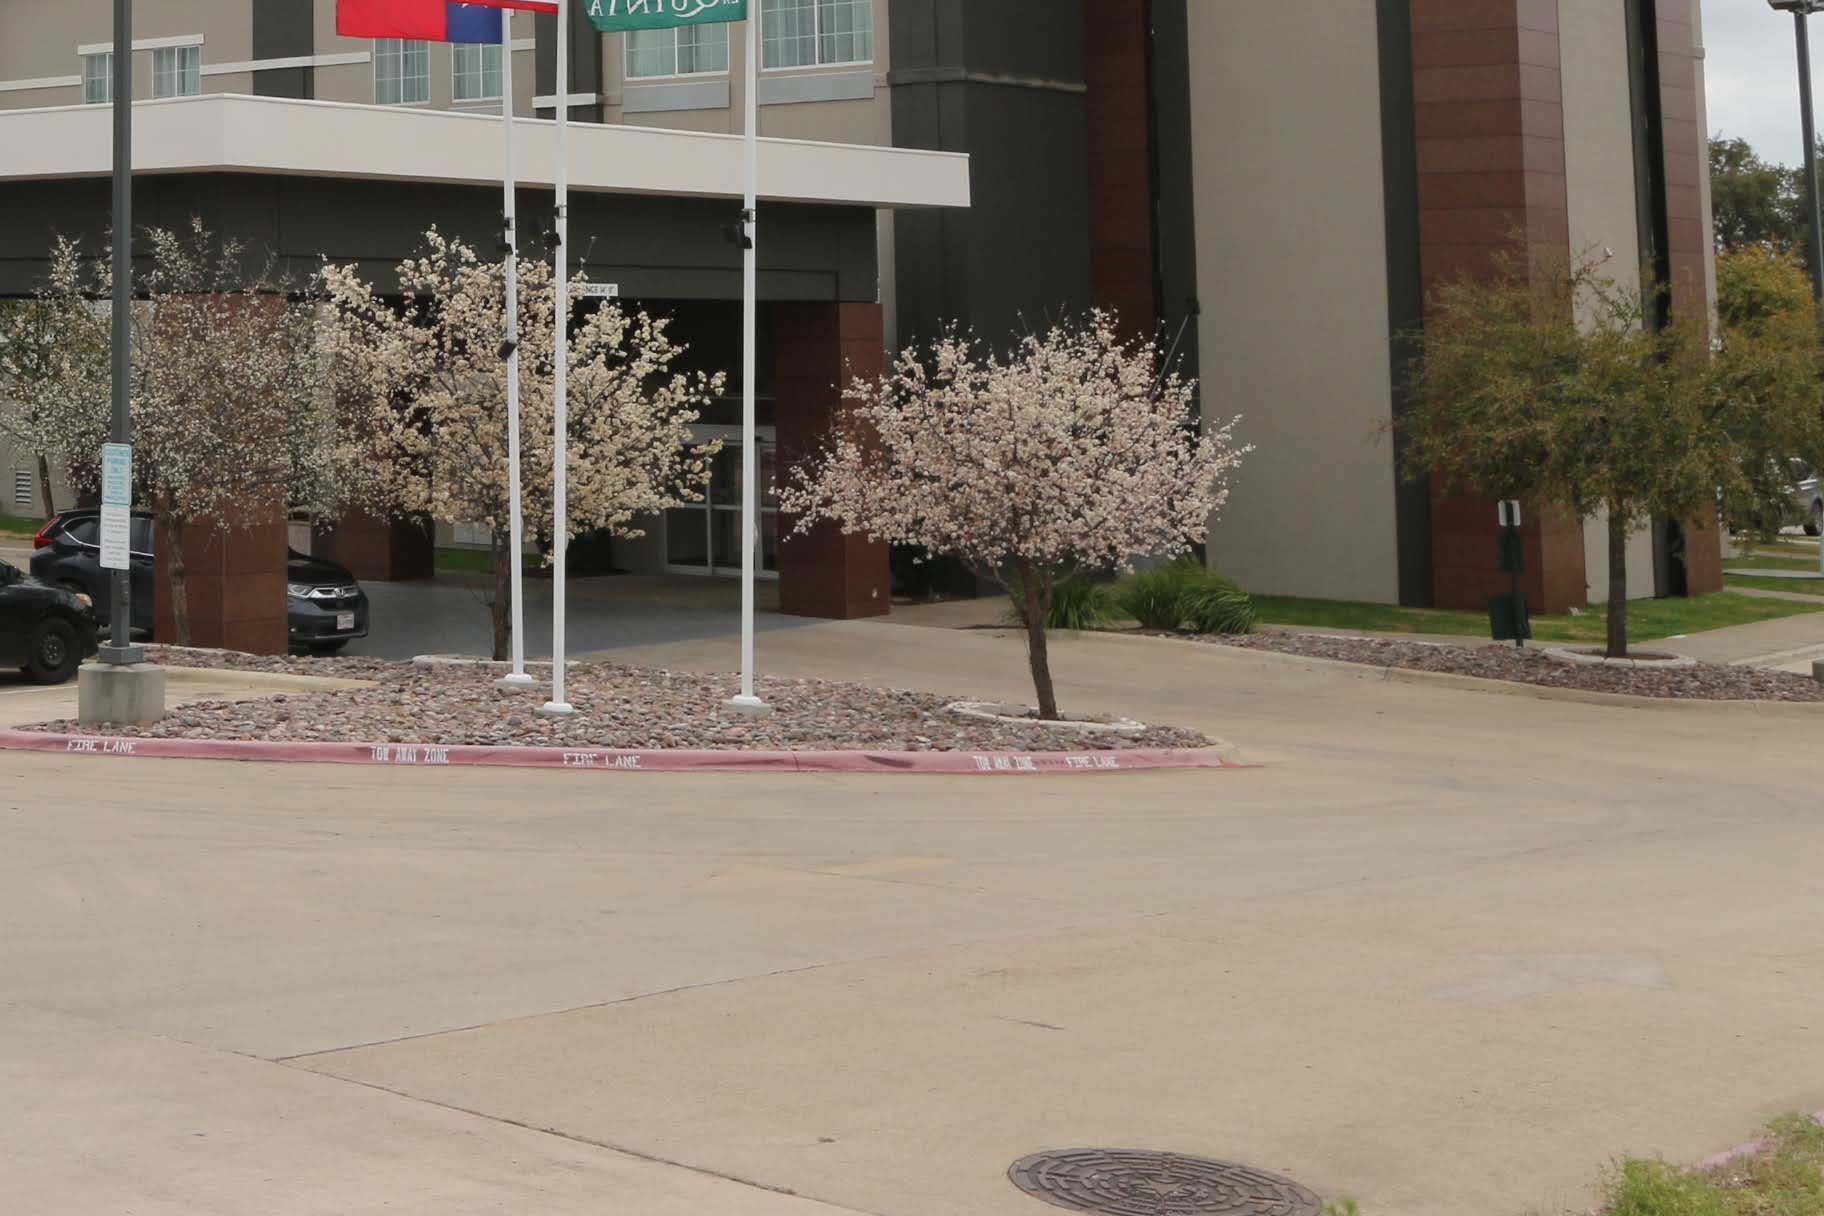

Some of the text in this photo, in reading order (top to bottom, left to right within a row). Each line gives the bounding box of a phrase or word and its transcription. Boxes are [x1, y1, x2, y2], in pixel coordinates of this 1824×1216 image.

[66, 739, 136, 754] FIRE LANE
[370, 745, 449, 763] TOW AWAY ZONE
[605, 754, 641, 768] LANE
